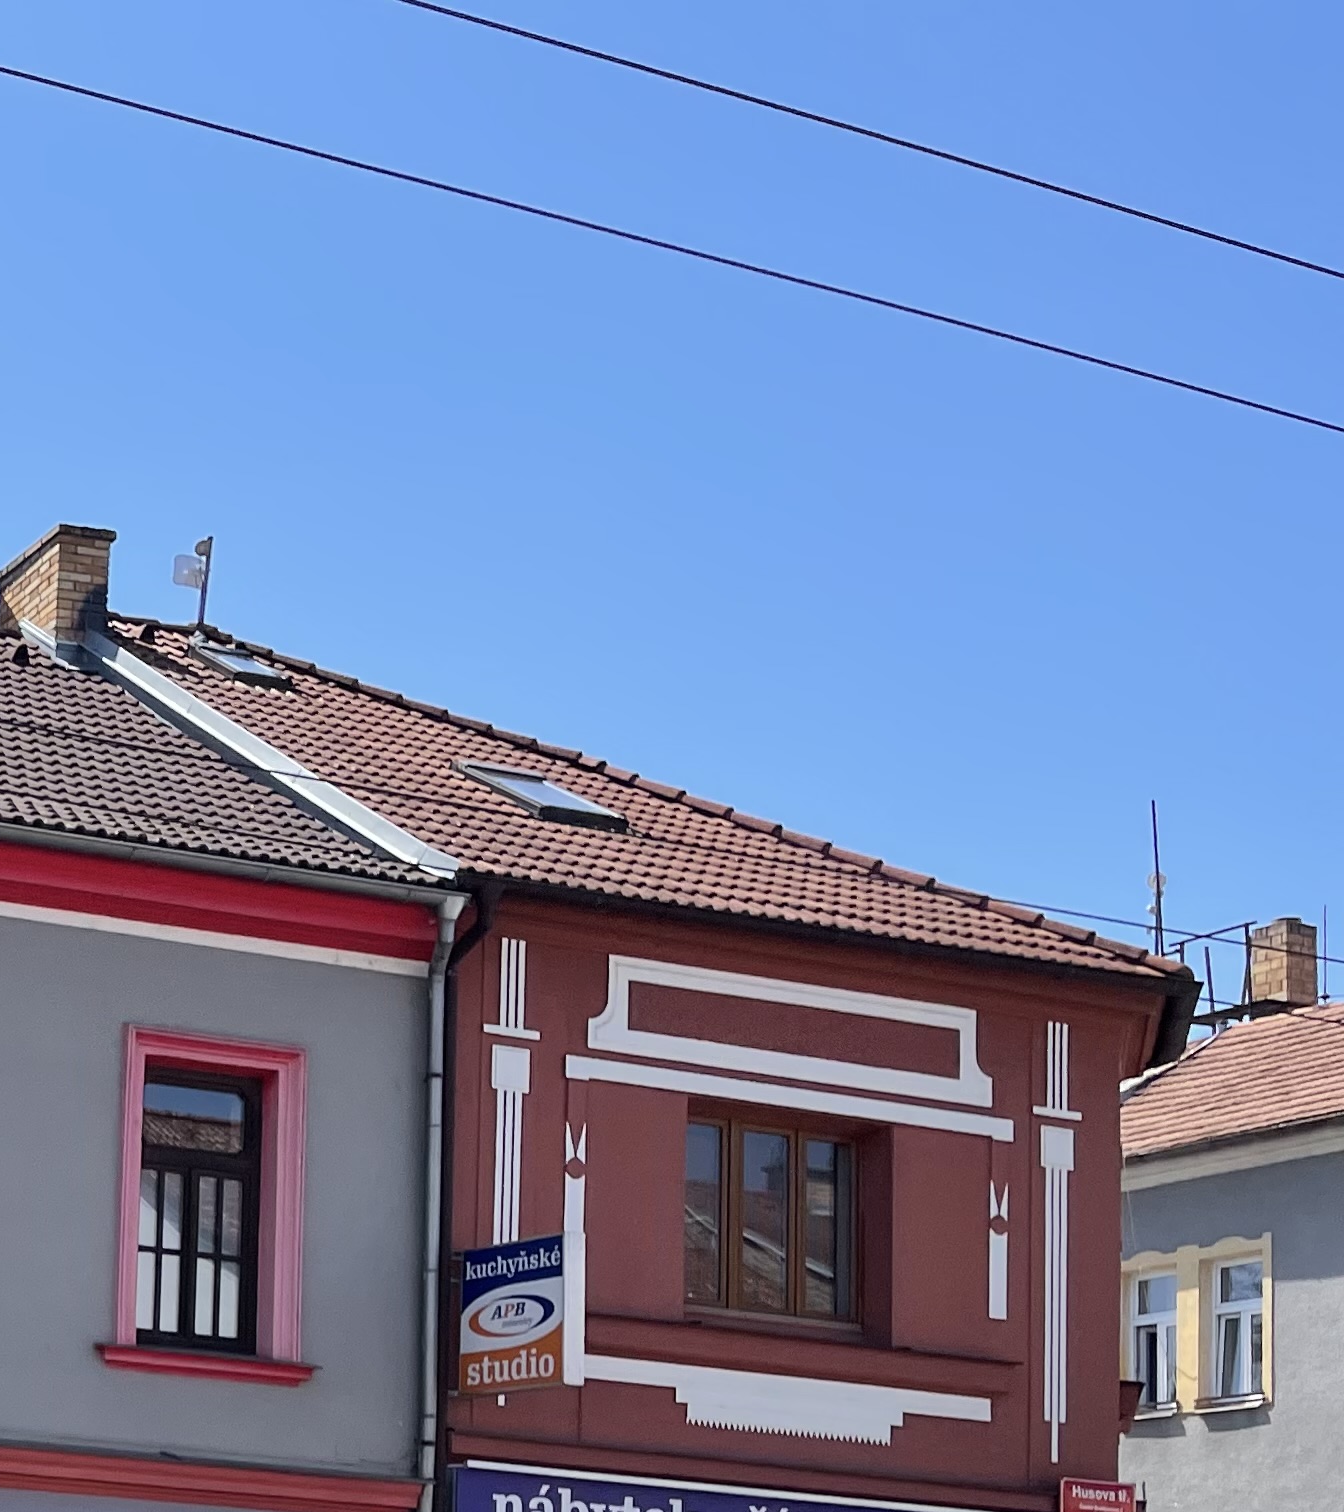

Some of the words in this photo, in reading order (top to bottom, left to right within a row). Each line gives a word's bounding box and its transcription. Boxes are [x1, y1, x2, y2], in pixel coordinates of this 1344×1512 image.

[465, 1244, 561, 1280] kuchyňské
[491, 1301, 526, 1320] APB
[466, 1348, 555, 1386] studio
[1072, 1484, 1116, 1502] Husova
